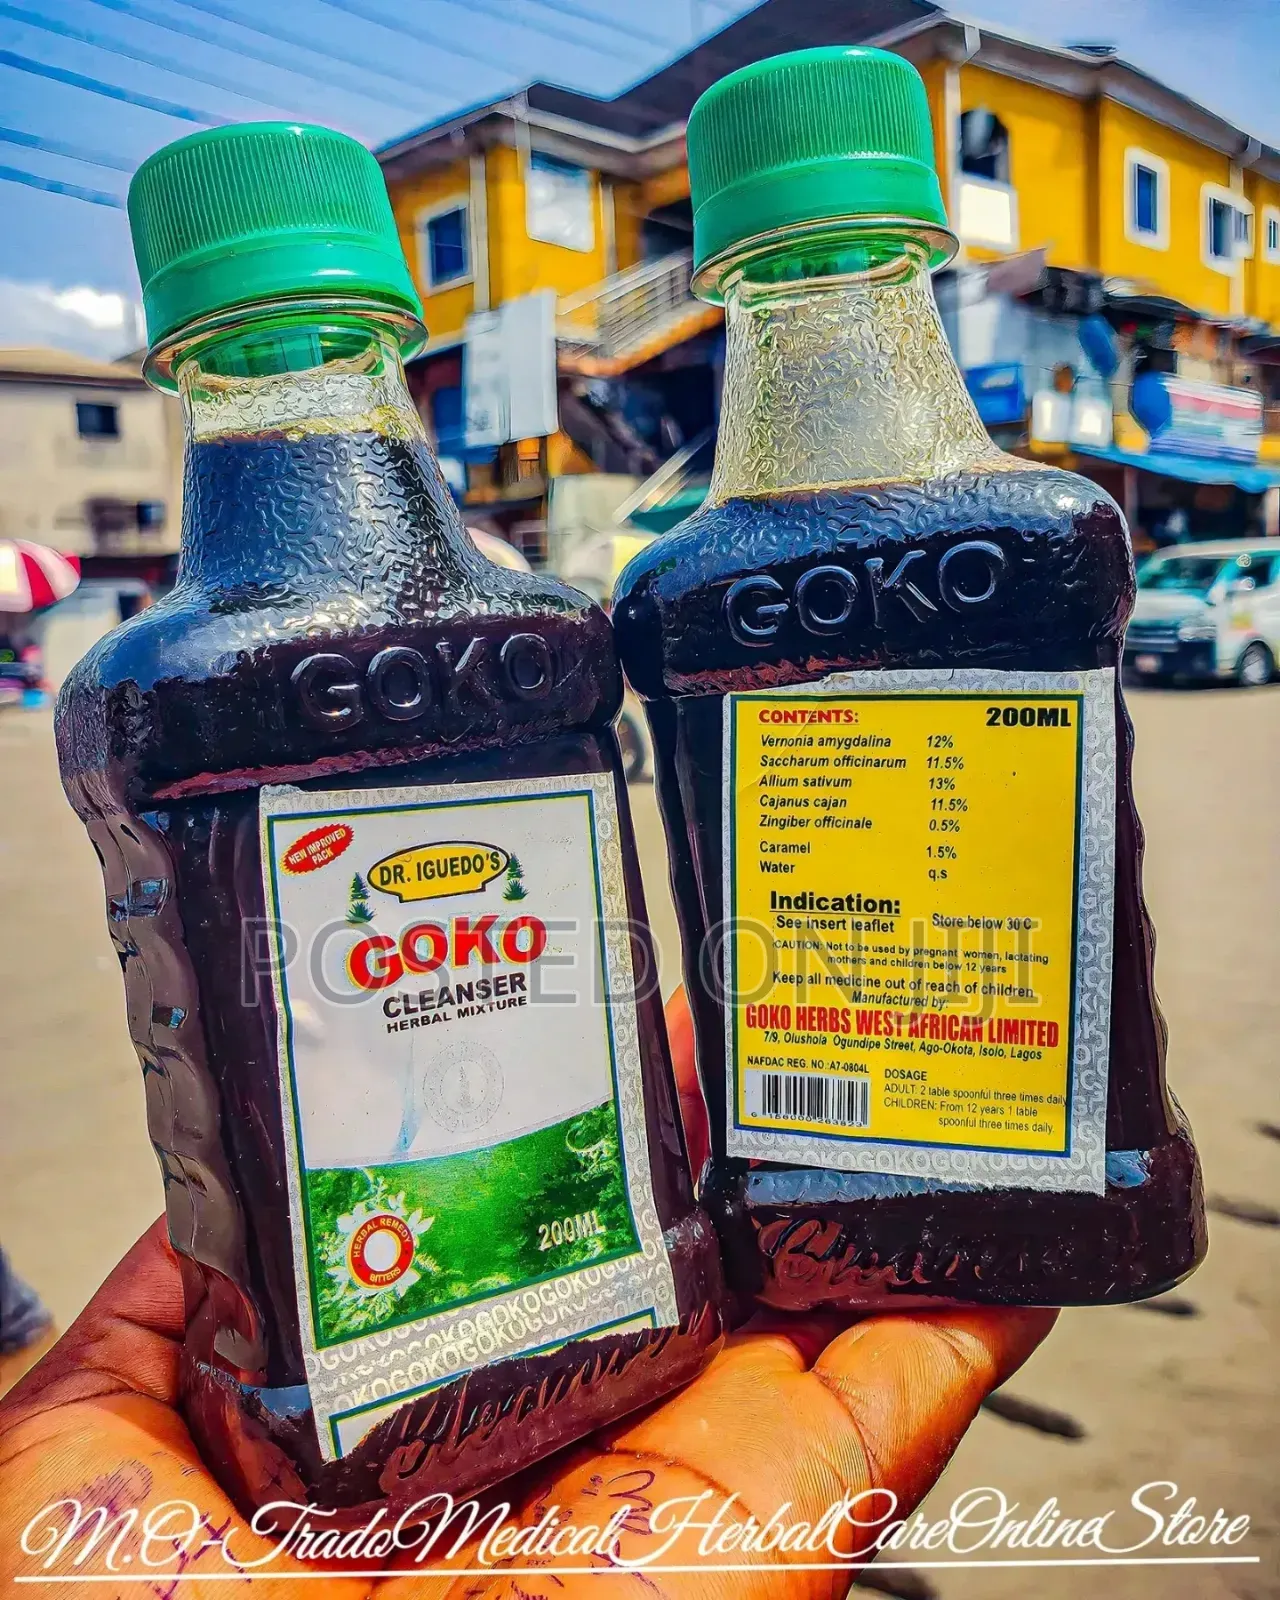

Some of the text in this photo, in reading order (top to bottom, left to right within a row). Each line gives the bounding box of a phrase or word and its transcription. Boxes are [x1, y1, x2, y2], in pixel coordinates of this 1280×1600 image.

[721, 539, 1008, 648] GOKO
[290, 632, 554, 729] GOKO
[758, 709, 860, 725] CONTENTS:
[985, 706, 1072, 728] 200ML
[760, 734, 892, 750] Vernonia amygdalina
[926, 734, 954, 749] 12%
[759, 754, 907, 769] Saccharum officinarum
[926, 756, 964, 770] 11.5%
[758, 774, 852, 788] Allium sativum
[928, 777, 956, 791] 13%
[759, 794, 847, 811] Cajanus cajan
[931, 798, 969, 812] 11.5%
[759, 814, 873, 830] Zingiber officinale
[928, 818, 961, 833] 0.5%
[287, 826, 347, 865] NEW IMPROVED
[759, 840, 811, 854] Caramel
[926, 845, 957, 860] 1.5%
[311, 846, 334, 865] PACK
[379, 851, 501, 886] DR. IGUEDO'S
[759, 860, 796, 874] Water
[928, 868, 948, 882] q.s
[770, 890, 901, 915] Indication:
[776, 914, 895, 933] See insert leaflet
[931, 912, 964, 929] Store
[967, 914, 1004, 930] below
[348, 914, 548, 991] GOKO
[826, 941, 843, 952] Not
[845, 943, 855, 952] to
[857, 943, 869, 953] be
[872, 944, 896, 955] used
[898, 945, 910, 957] by
[913, 947, 958, 960] pregnant
[963, 949, 1003, 962] women,
[1005, 951, 1049, 965] lactating
[827, 955, 1007, 974] mothers and children below 12 years
[772, 971, 1035, 998] Keep all medicine out of reach of children
[382, 972, 528, 1019] CLEANSER
[851, 990, 949, 1012] Manufactured by:
[386, 995, 528, 1034] HERBAL MIXTURE
[745, 1003, 1060, 1048] GOKO HERBS WEST AFRICAN LIMITED
[764, 1030, 1043, 1063] 7/9, Olushola Ogundipe Street, Ago-Okota, Isolo, Lagos
[747, 1055, 785, 1068] NAFDAC
[787, 1058, 809, 1069] REG.
[884, 1068, 928, 1082] DOSAGE
[884, 1084, 1067, 1108] ADULT: 2 table spoonful three times daily
[884, 1097, 1038, 1117] CHILDREN: From 12 years 1 table
[938, 1115, 1055, 1136] spoonful three times daily.
[353, 1217, 412, 1258] HERBAL REMEDY
[537, 1209, 607, 1252] 200ML
[369, 1266, 402, 1283] BITTERS
